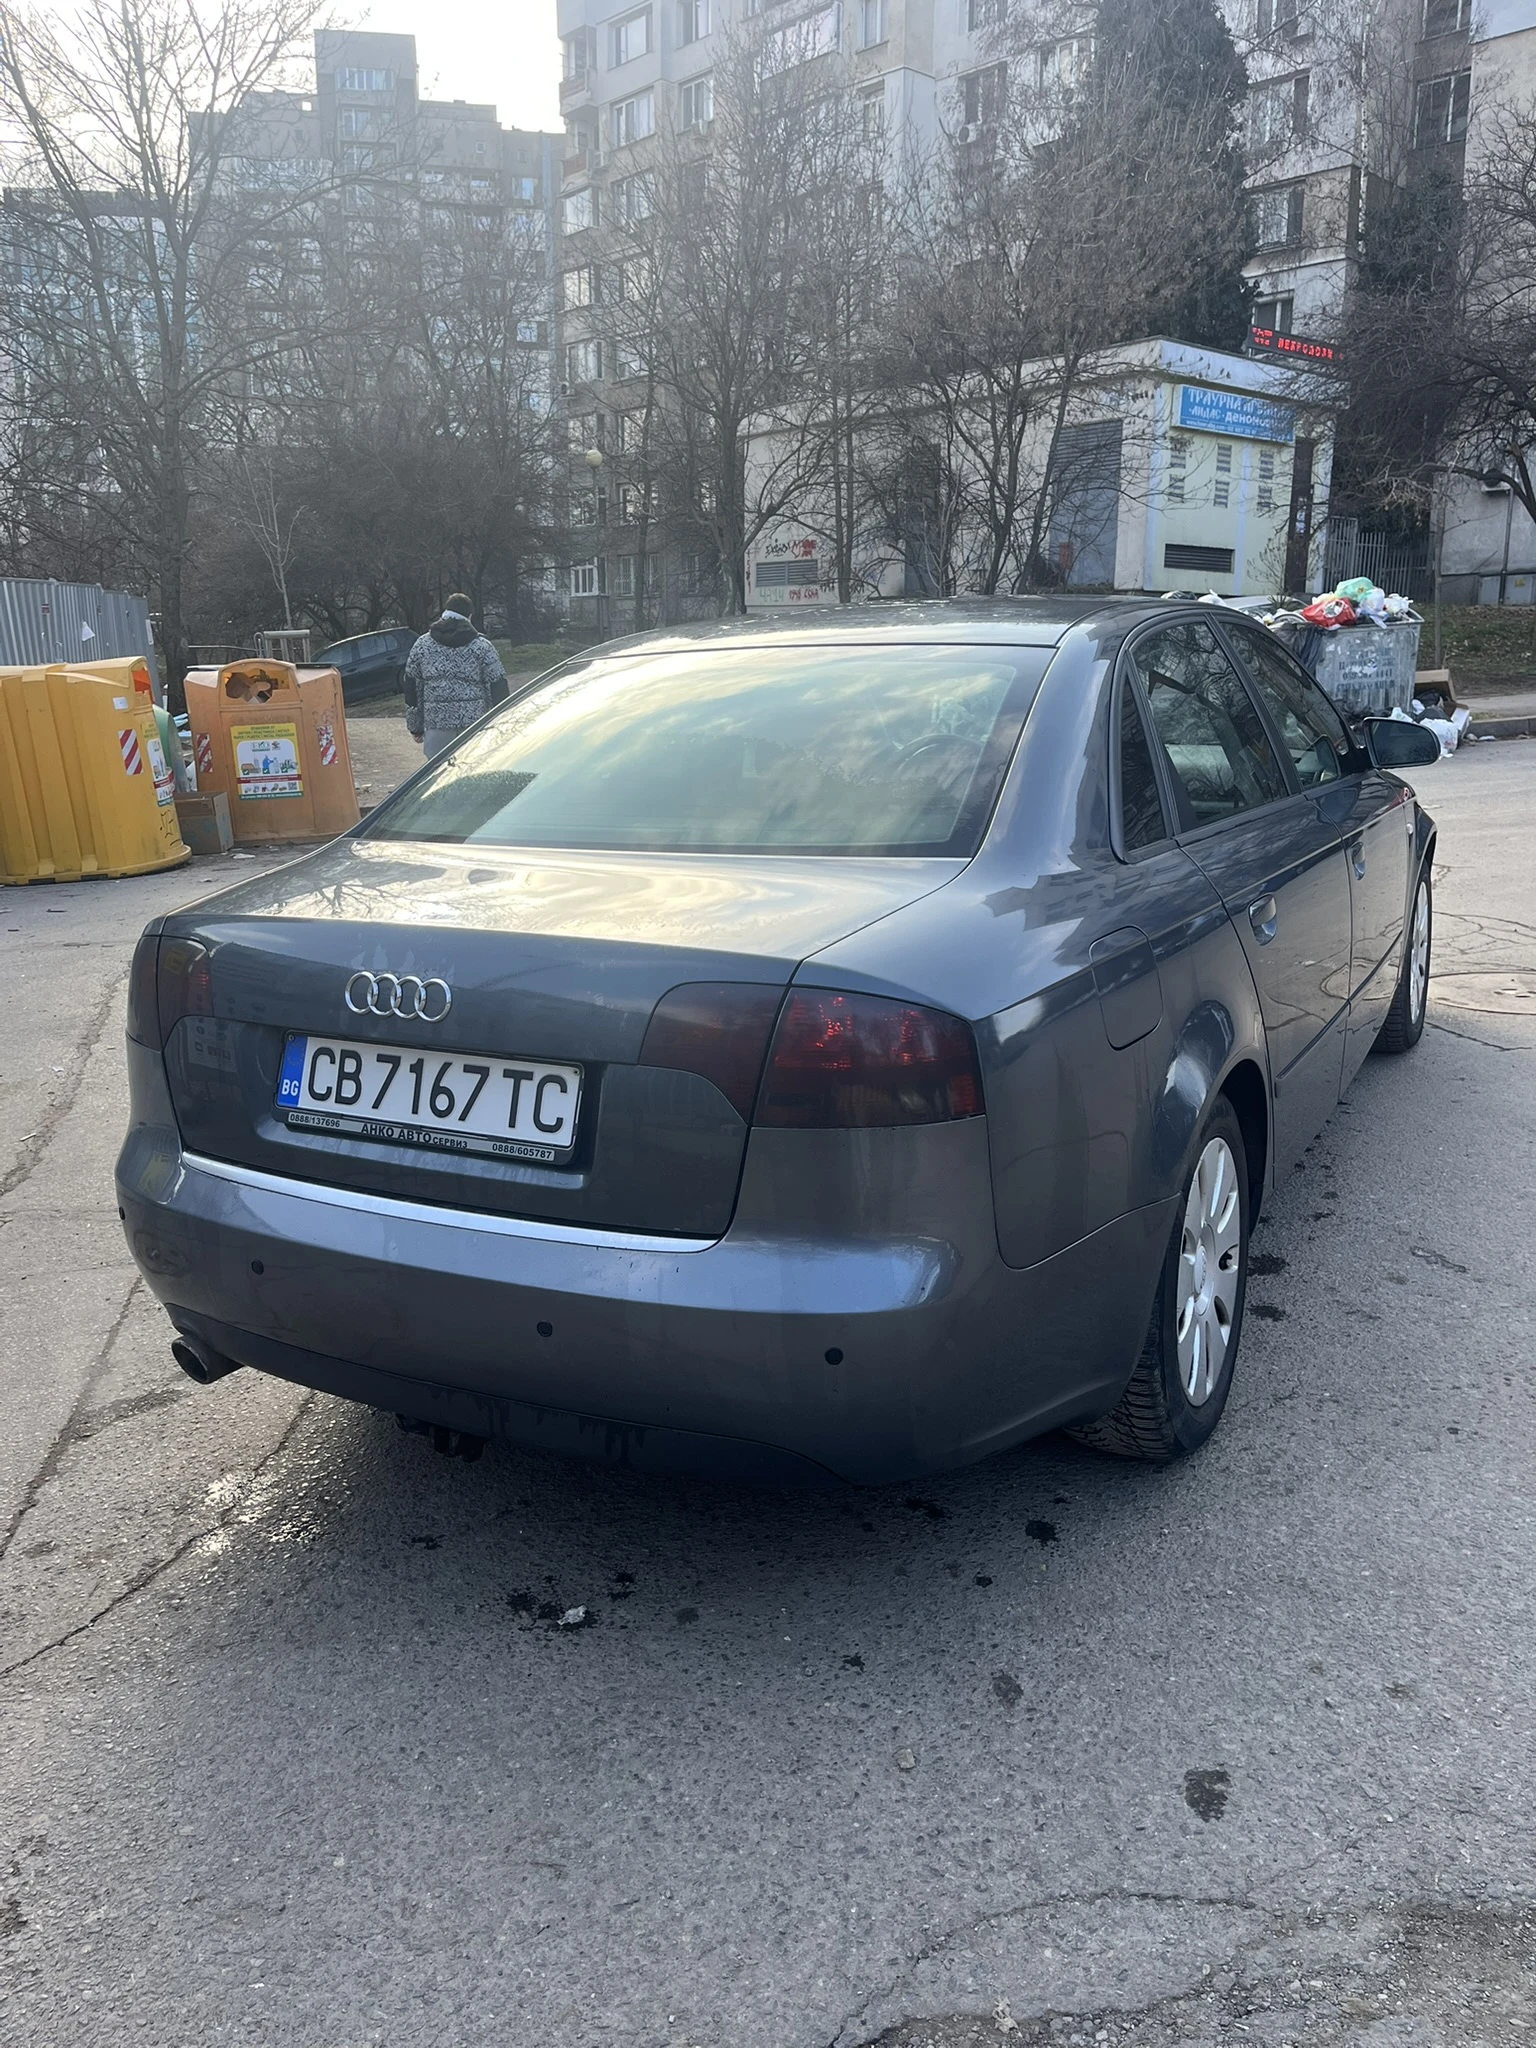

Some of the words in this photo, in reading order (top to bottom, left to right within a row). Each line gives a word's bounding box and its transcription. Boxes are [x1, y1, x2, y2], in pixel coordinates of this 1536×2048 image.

[1188, 387, 1242, 411] ТРАУРНА
[281, 1078, 300, 1097] BG
[290, 1113, 341, 1128] 0888/137696
[361, 1123, 394, 1138] АНКО
[492, 1143, 552, 1160] 0888/605787
